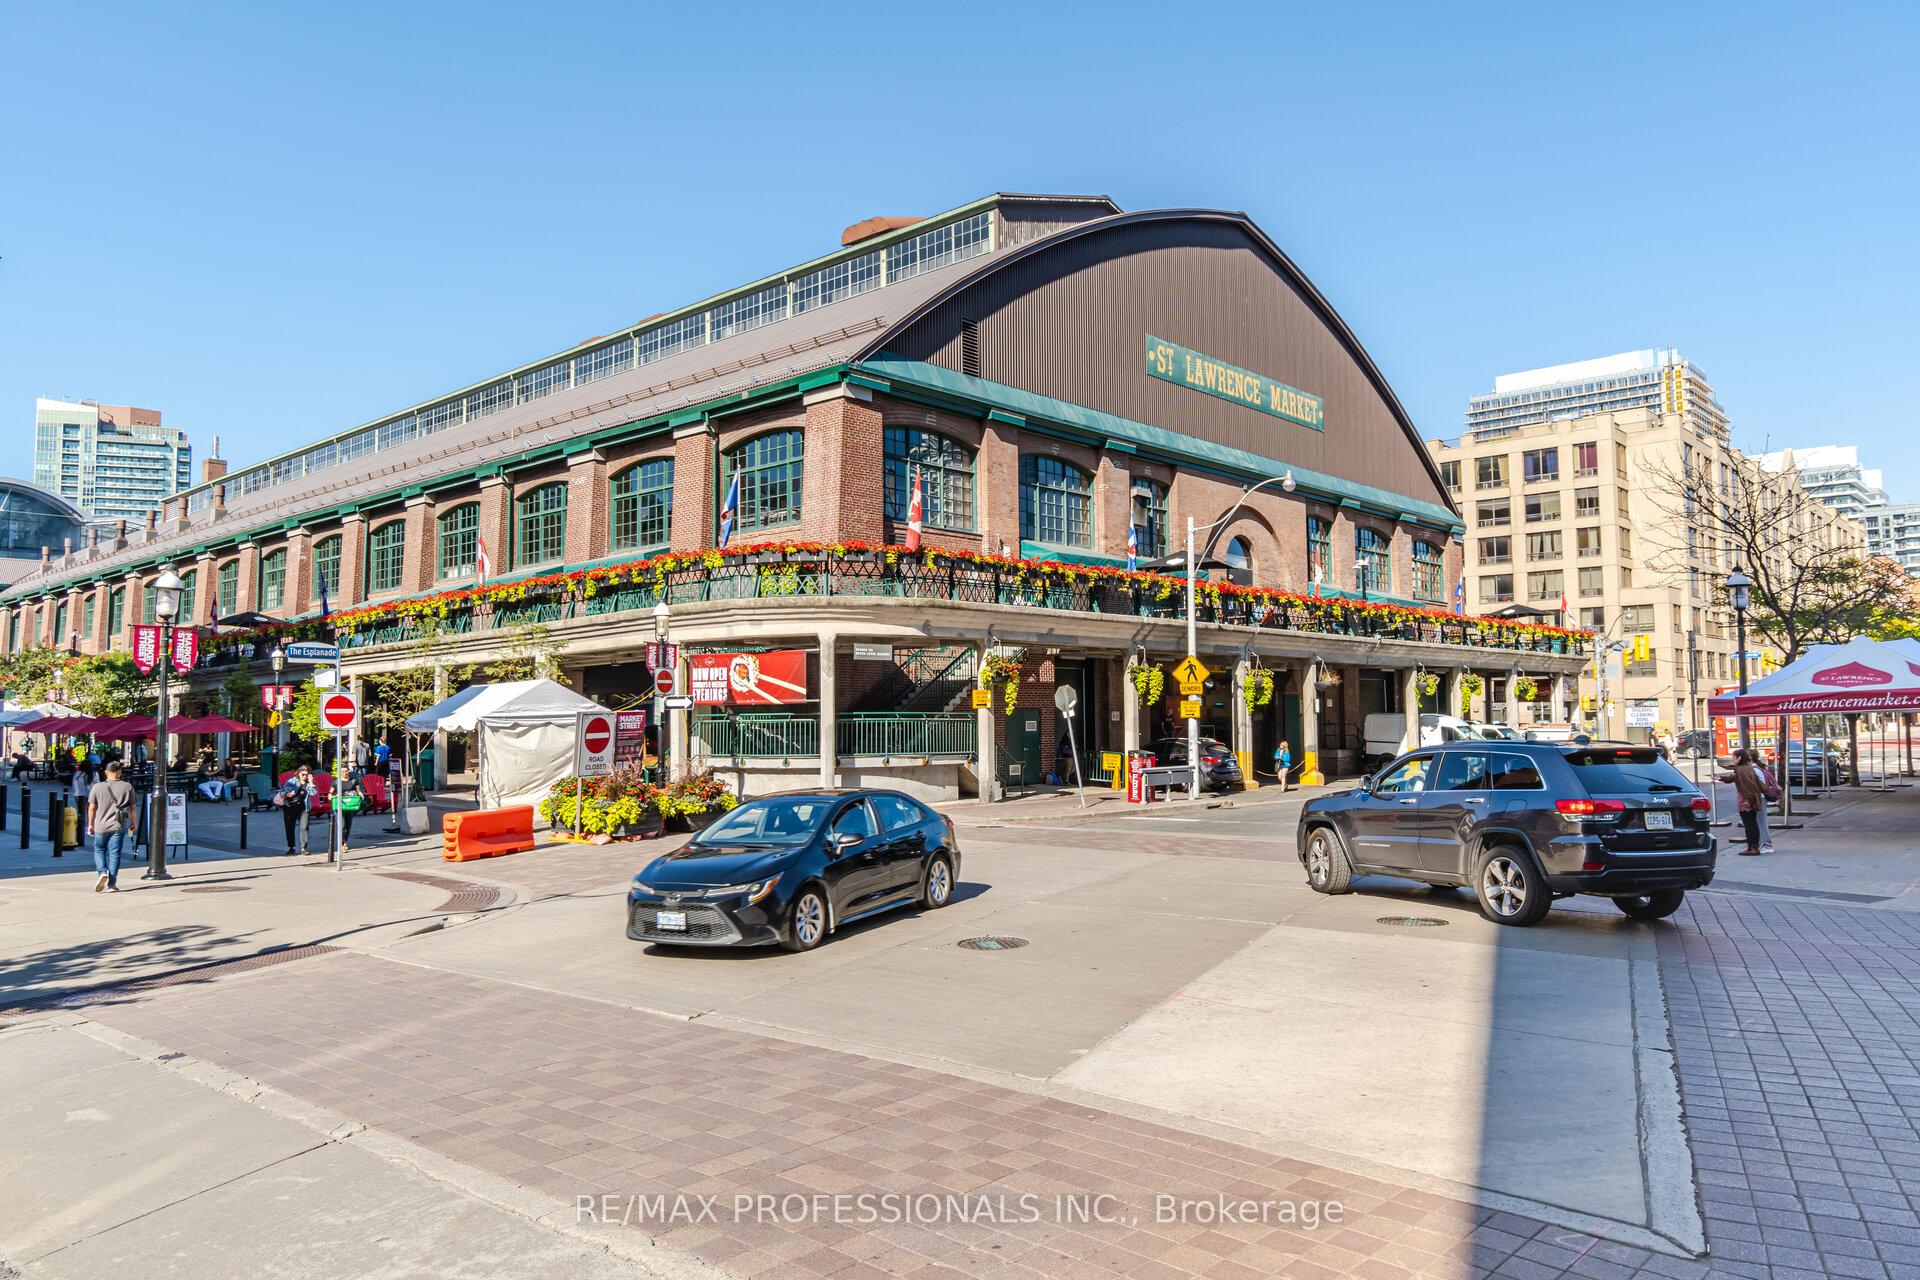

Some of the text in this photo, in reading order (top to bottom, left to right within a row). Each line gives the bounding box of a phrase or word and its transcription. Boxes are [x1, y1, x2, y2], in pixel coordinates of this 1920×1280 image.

[1186, 354, 1261, 405] LAWRENCE
[1270, 384, 1318, 424] MARKET
[138, 630, 147, 662] STREET
[146, 629, 155, 667] MARKET
[176, 632, 185, 664] STREET
[183, 633, 193, 668] MARKET
[290, 648, 337, 658] The Esplanade
[693, 667, 728, 681] NOW OPEN
[693, 688, 728, 701] EVENINGS
[620, 715, 643, 723] MARKET
[620, 722, 641, 730] STREET
[585, 763, 606, 771] CLOSED
[1652, 797, 1669, 805] Jeep
